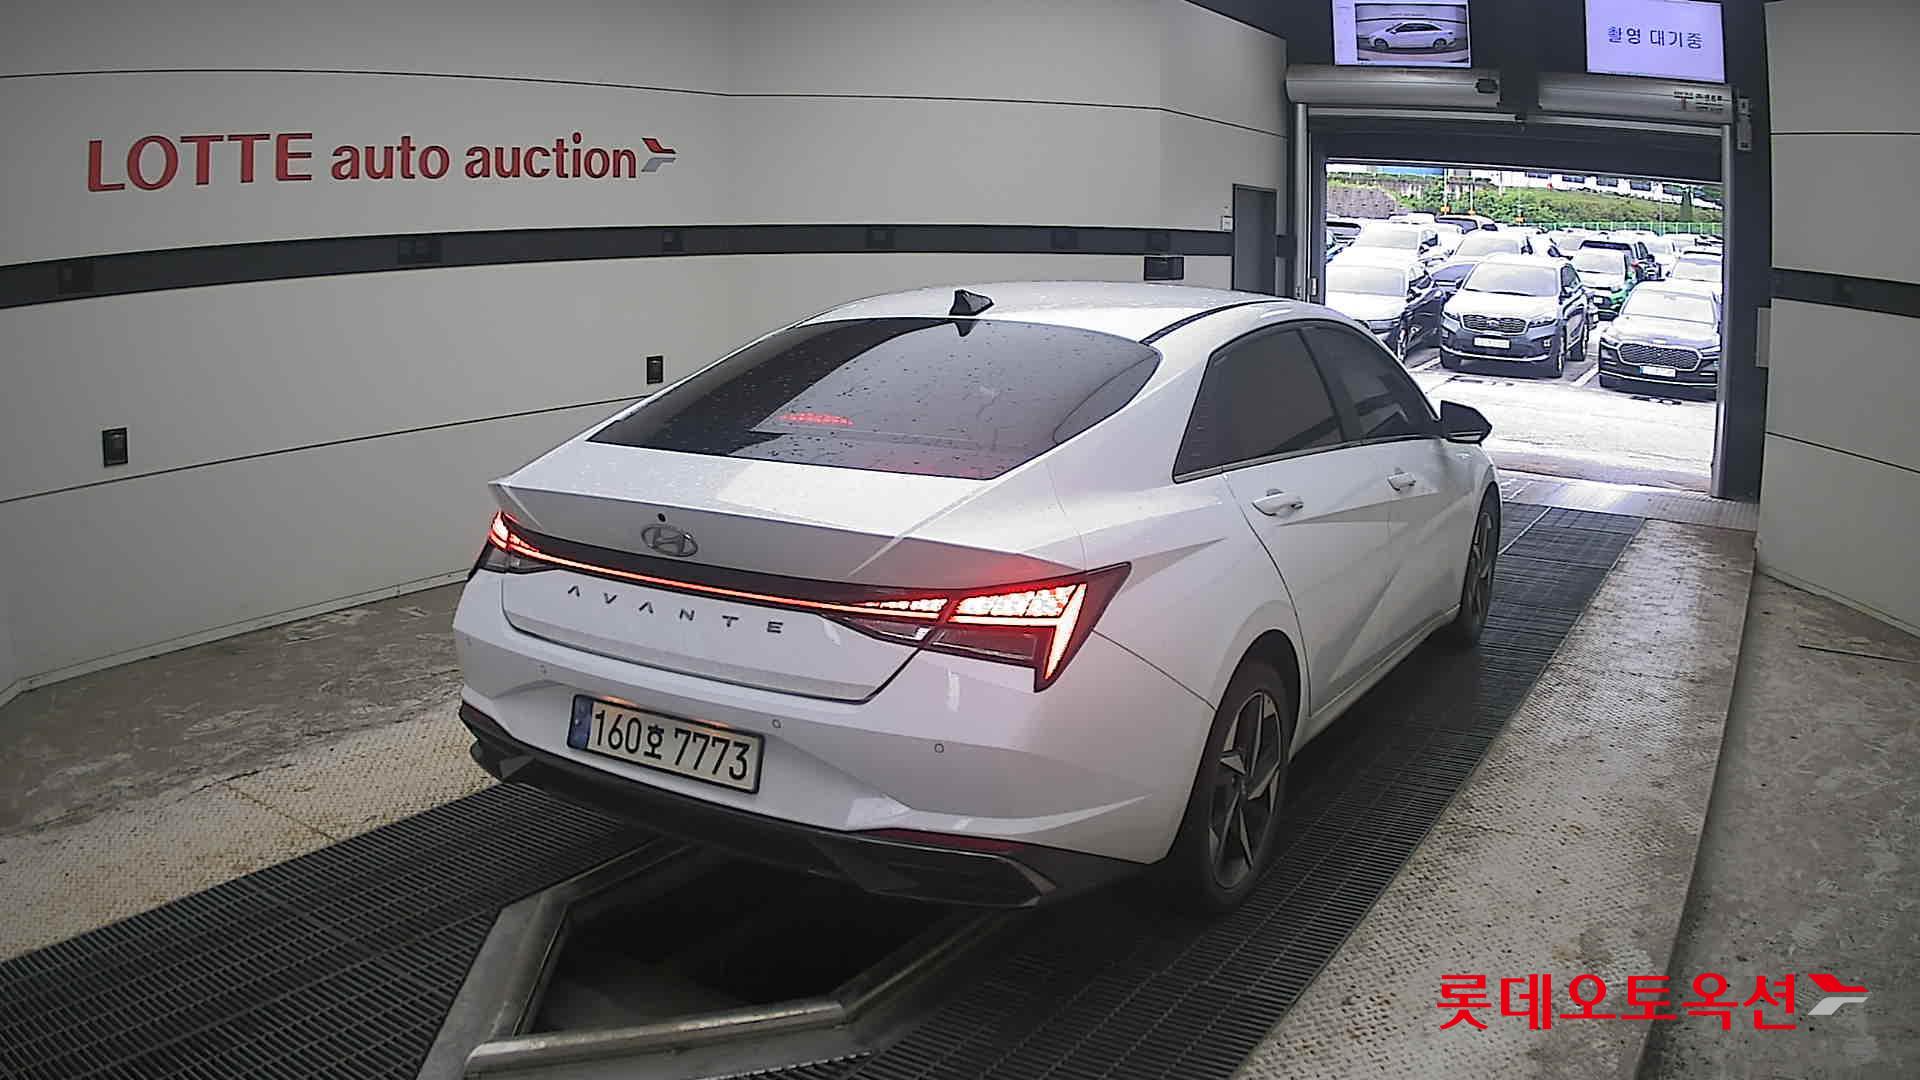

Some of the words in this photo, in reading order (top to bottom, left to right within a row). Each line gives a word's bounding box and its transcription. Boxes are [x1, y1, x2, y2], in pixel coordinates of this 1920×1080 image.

[1650, 29, 1702, 49] 대기중
[88, 132, 313, 192] LOTTE
[331, 135, 450, 180] auto
[464, 132, 637, 179] auction
[567, 585, 784, 633] AVANTE
